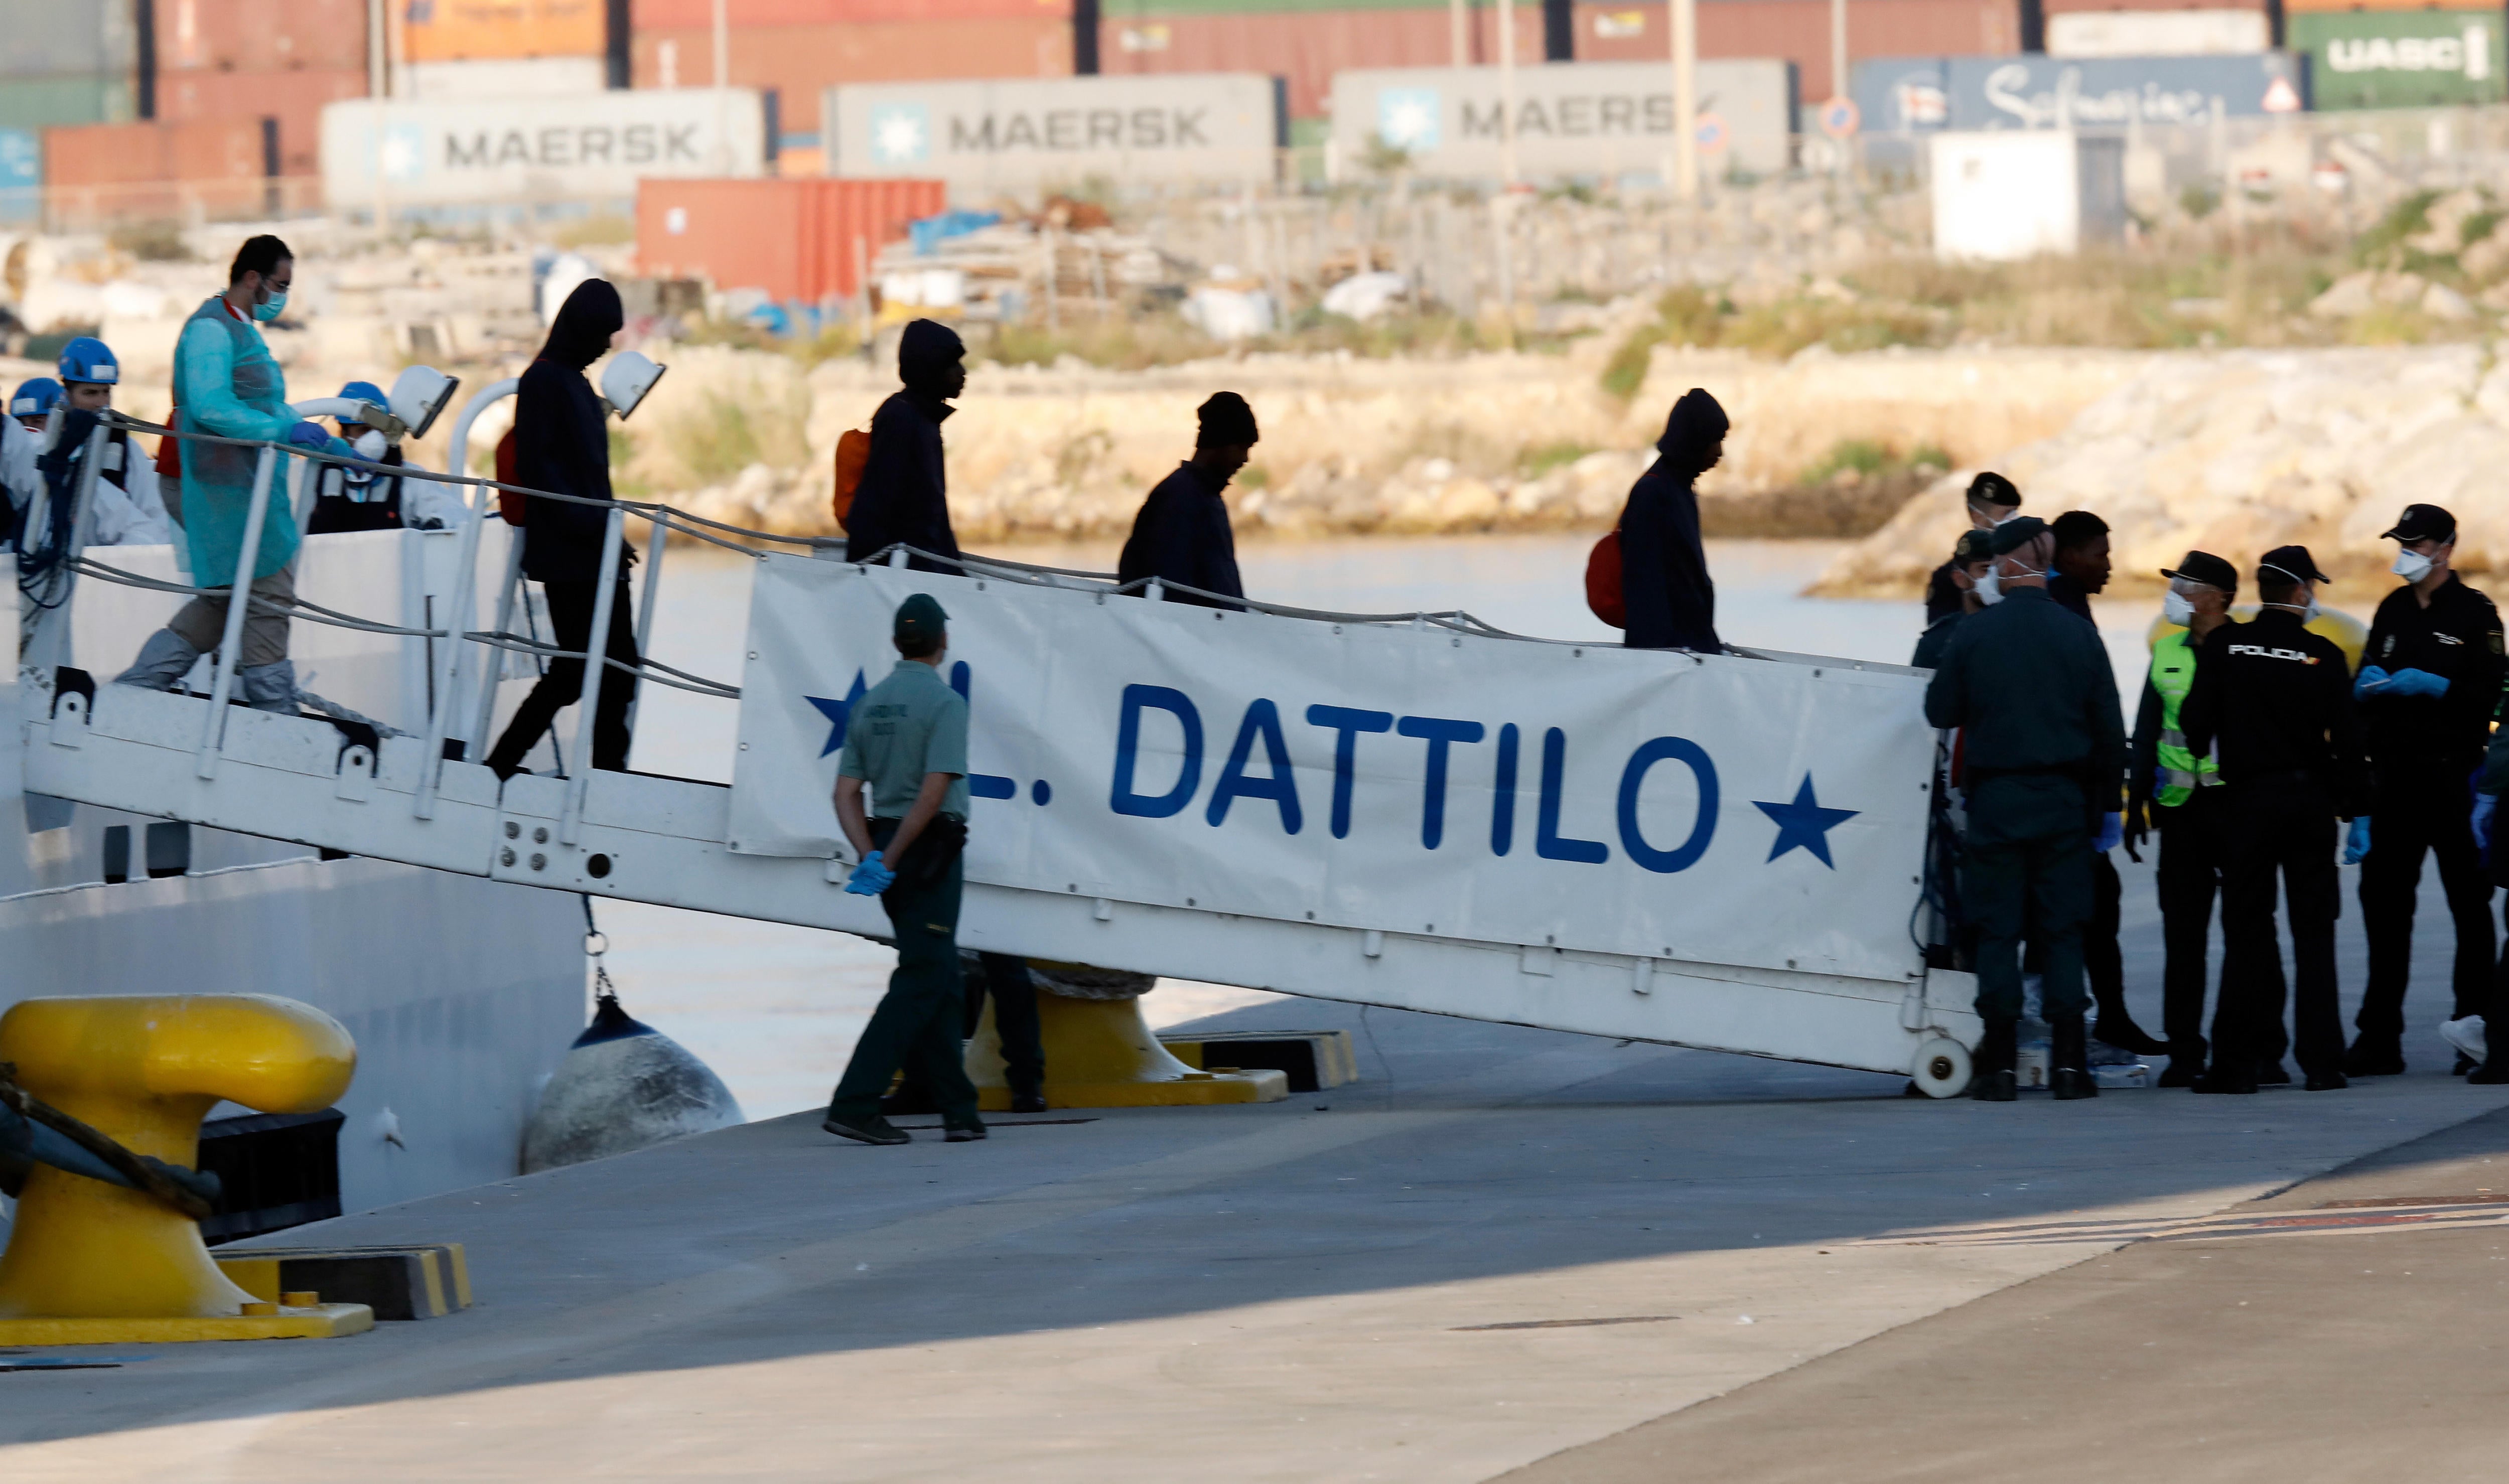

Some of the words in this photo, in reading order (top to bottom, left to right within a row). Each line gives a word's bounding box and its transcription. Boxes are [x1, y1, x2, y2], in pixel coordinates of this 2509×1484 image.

[2329, 38, 2463, 71] UASC
[445, 123, 701, 170] MAERSK
[948, 106, 1210, 153] MAERSK
[1109, 684, 1720, 873] DATTILO
